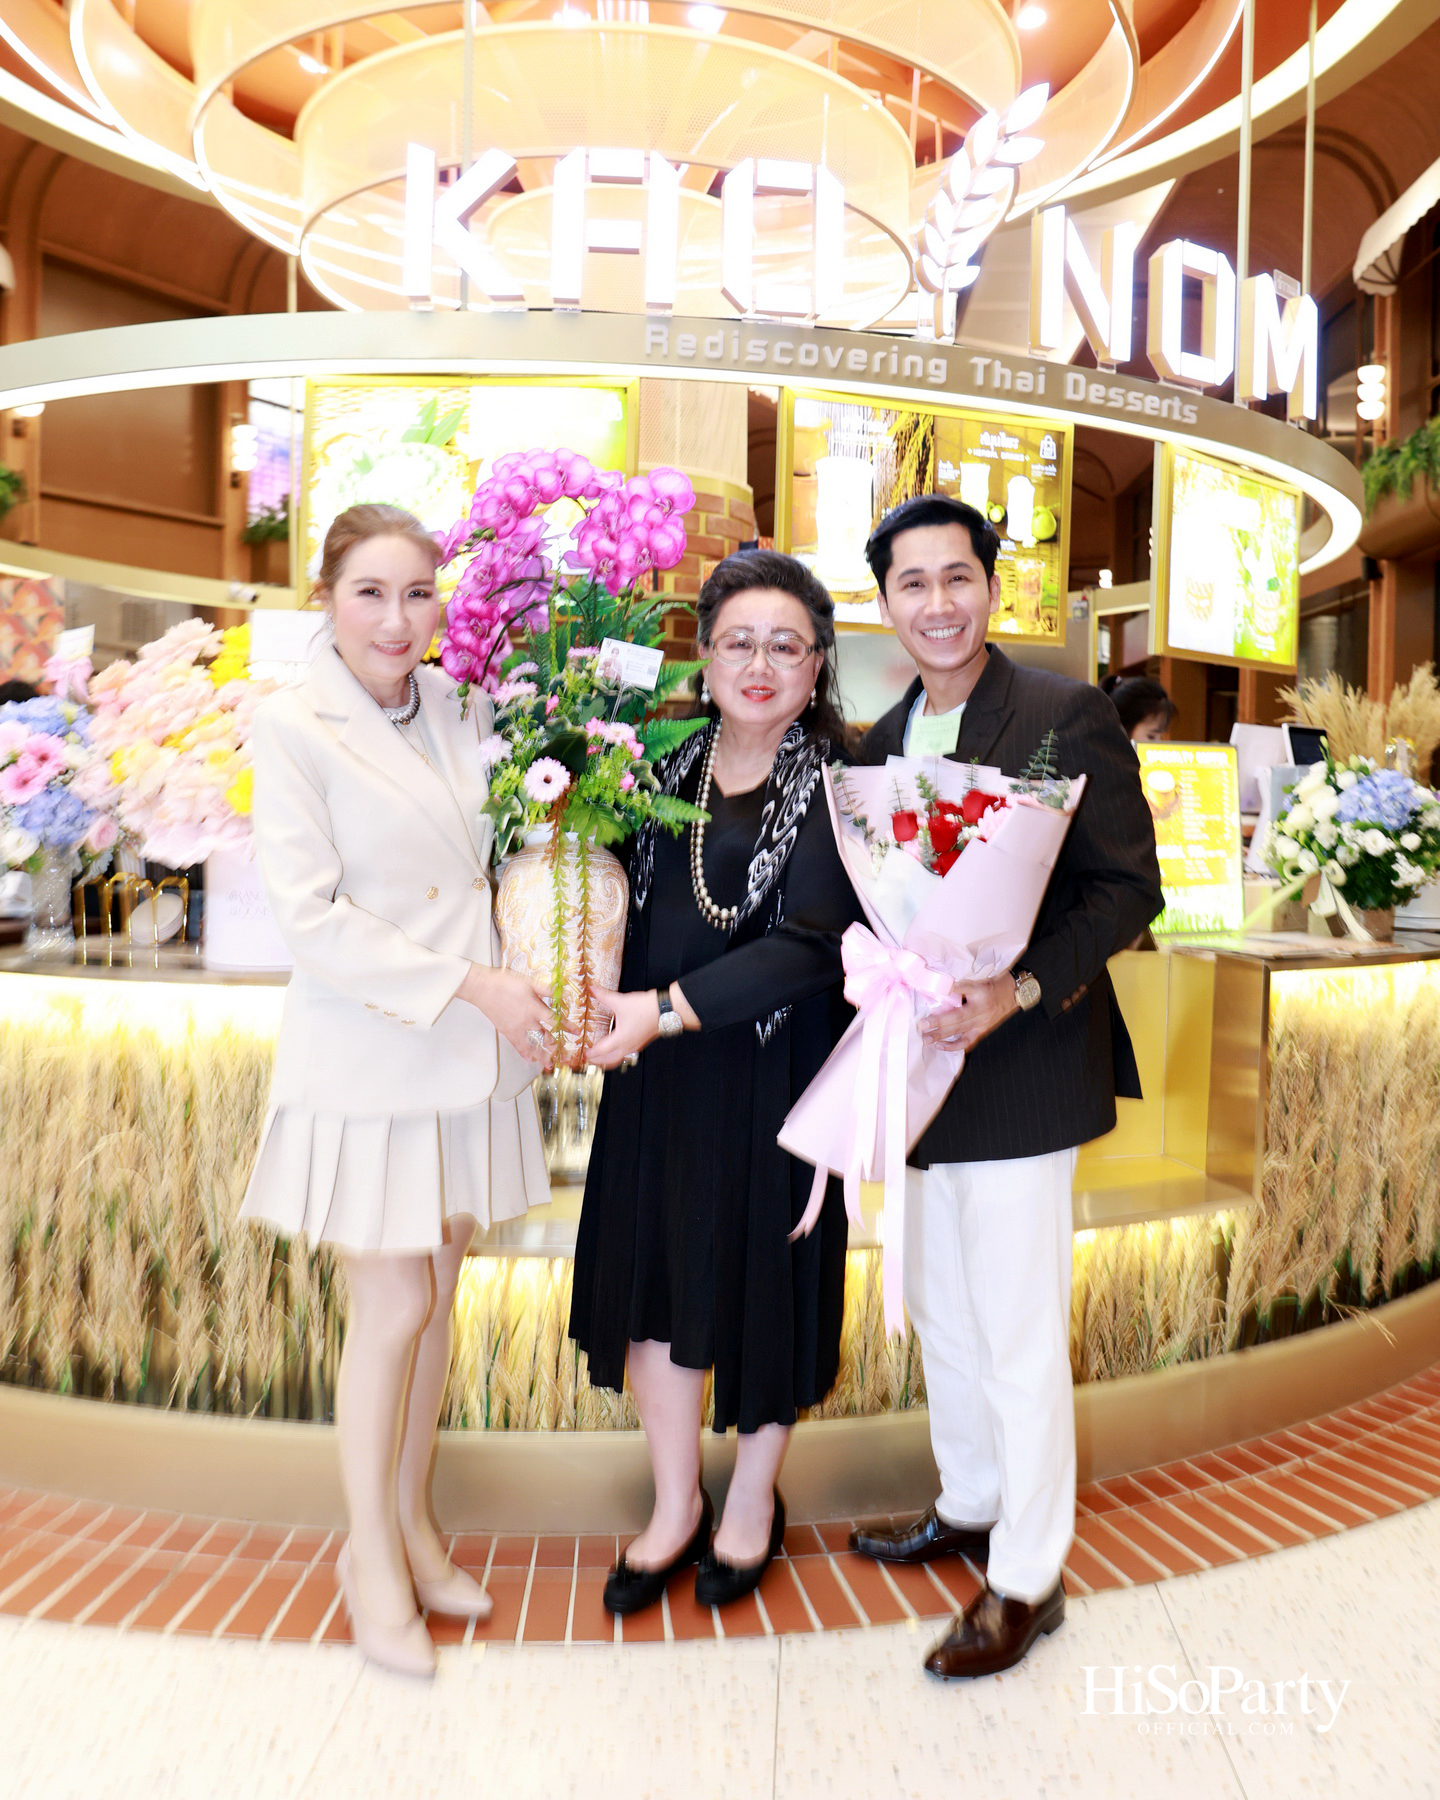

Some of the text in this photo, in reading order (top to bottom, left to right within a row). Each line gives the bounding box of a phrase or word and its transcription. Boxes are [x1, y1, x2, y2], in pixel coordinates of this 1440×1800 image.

[403, 142, 1319, 421] KAO NOM
[645, 323, 1199, 425] Rediscovering Thai Desserts
